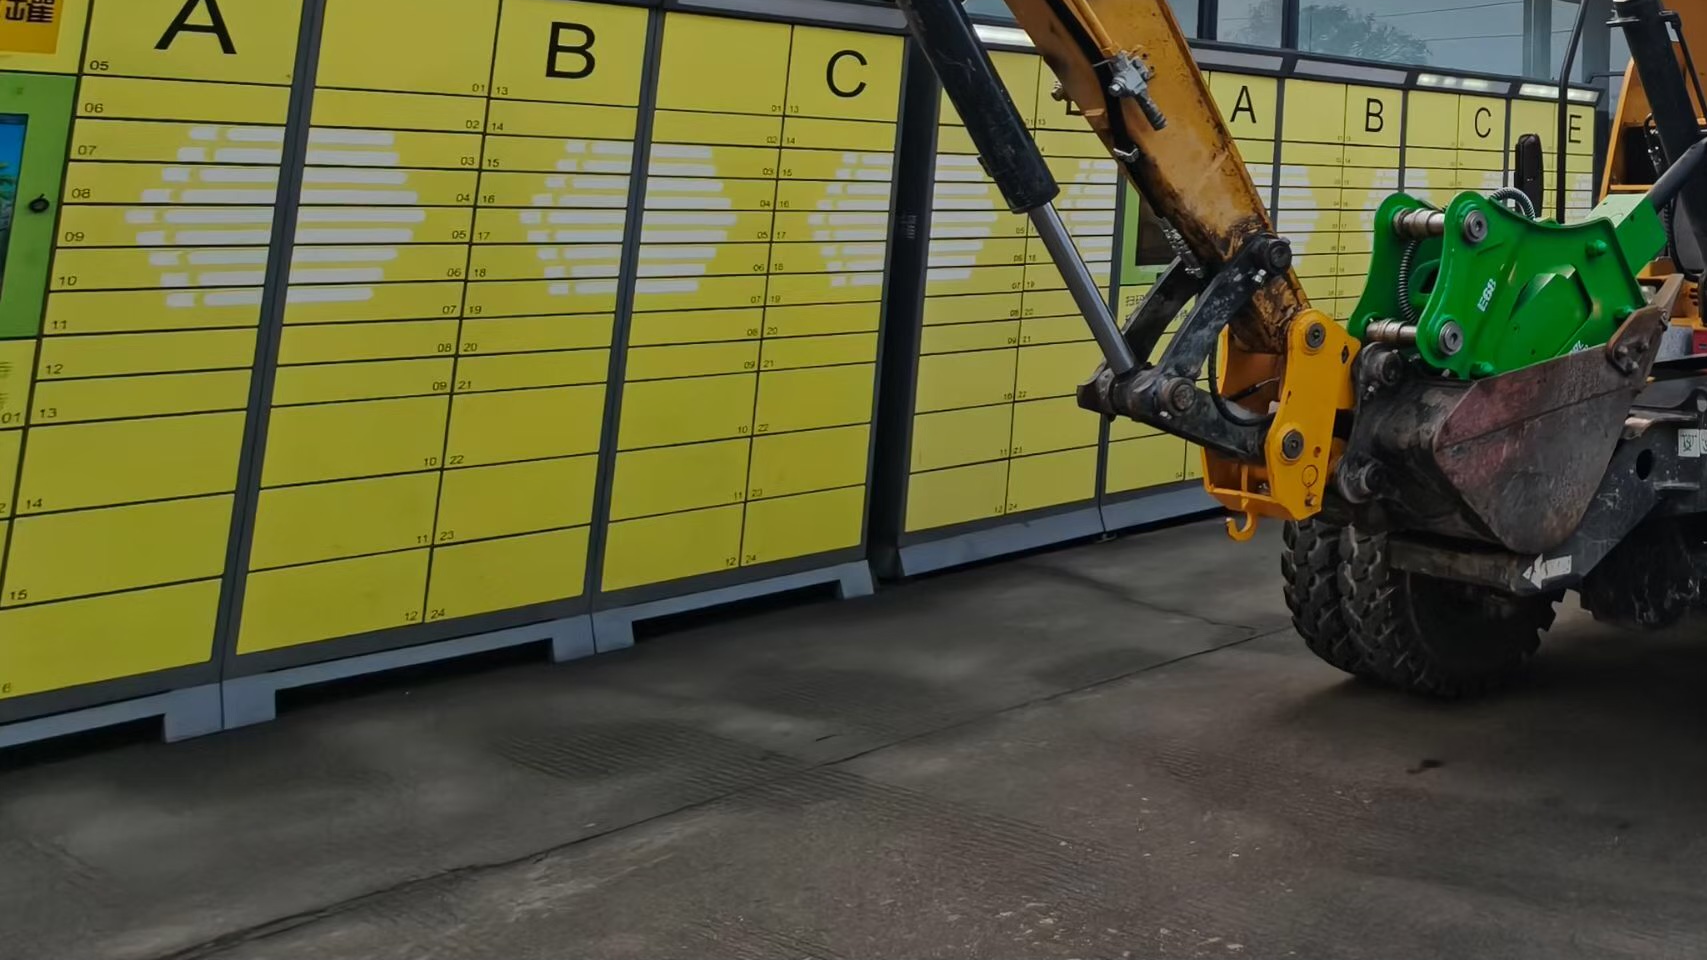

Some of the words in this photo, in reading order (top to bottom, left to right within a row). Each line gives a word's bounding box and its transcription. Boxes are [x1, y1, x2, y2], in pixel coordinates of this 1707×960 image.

[545, 21, 596, 79] B
[89, 61, 109, 71] 05
[825, 50, 868, 98] C
[472, 83, 485, 93] 01
[496, 86, 508, 95] 13
[84, 103, 104, 113] 06
[771, 104, 782, 113] 01
[789, 104, 799, 113] 13
[1230, 86, 1257, 124] A
[1365, 98, 1384, 133] B
[466, 120, 479, 129] 02
[491, 122, 504, 131] 14
[1474, 107, 1492, 138] C
[1567, 114, 1583, 144] E
[767, 136, 777, 145] 02
[786, 136, 795, 145] 14
[78, 145, 96, 155] 07
[461, 156, 475, 166] 03
[487, 159, 499, 167] 15
[763, 168, 773, 176] 03
[782, 169, 792, 177] 15
[72, 189, 90, 198] 08
[456, 193, 470, 202] 04
[482, 194, 495, 203] 16
[760, 200, 770, 208] 04
[780, 200, 789, 208] 16
[65, 232, 84, 241] 09
[452, 230, 466, 239] 05
[478, 230, 490, 239] 17
[757, 231, 768, 240] 05
[777, 231, 786, 239] 17
[753, 264, 764, 272] 06
[774, 263, 784, 271] 18
[447, 268, 461, 277] 06
[473, 268, 486, 277] 18
[59, 276, 77, 286] 10
[751, 295, 761, 304] 07
[770, 295, 780, 303] 19
[442, 305, 456, 314] 07
[469, 305, 481, 314] 19
[53, 320, 67, 330] 11
[747, 328, 758, 336] 08
[767, 327, 777, 335] 20
[438, 343, 452, 352] 08
[464, 342, 477, 352] 20
[744, 361, 755, 369] 09
[764, 360, 774, 368] 21
[46, 364, 63, 374] 12
[432, 381, 446, 391] 09
[458, 380, 471, 390] 21
[2, 412, 20, 423] 01
[40, 408, 57, 418] 13
[737, 425, 748, 434] 10
[758, 424, 769, 432] 22
[423, 457, 437, 467] 10
[450, 455, 464, 465] 22
[733, 492, 742, 500] 11
[752, 488, 763, 497] 23
[26, 499, 42, 510] 14
[416, 535, 429, 544] 11
[440, 531, 454, 540] 23
[725, 557, 736, 566] 12
[745, 554, 757, 563] 24
[10, 590, 27, 601] 15
[405, 611, 418, 620] 12
[431, 609, 445, 618] 24
